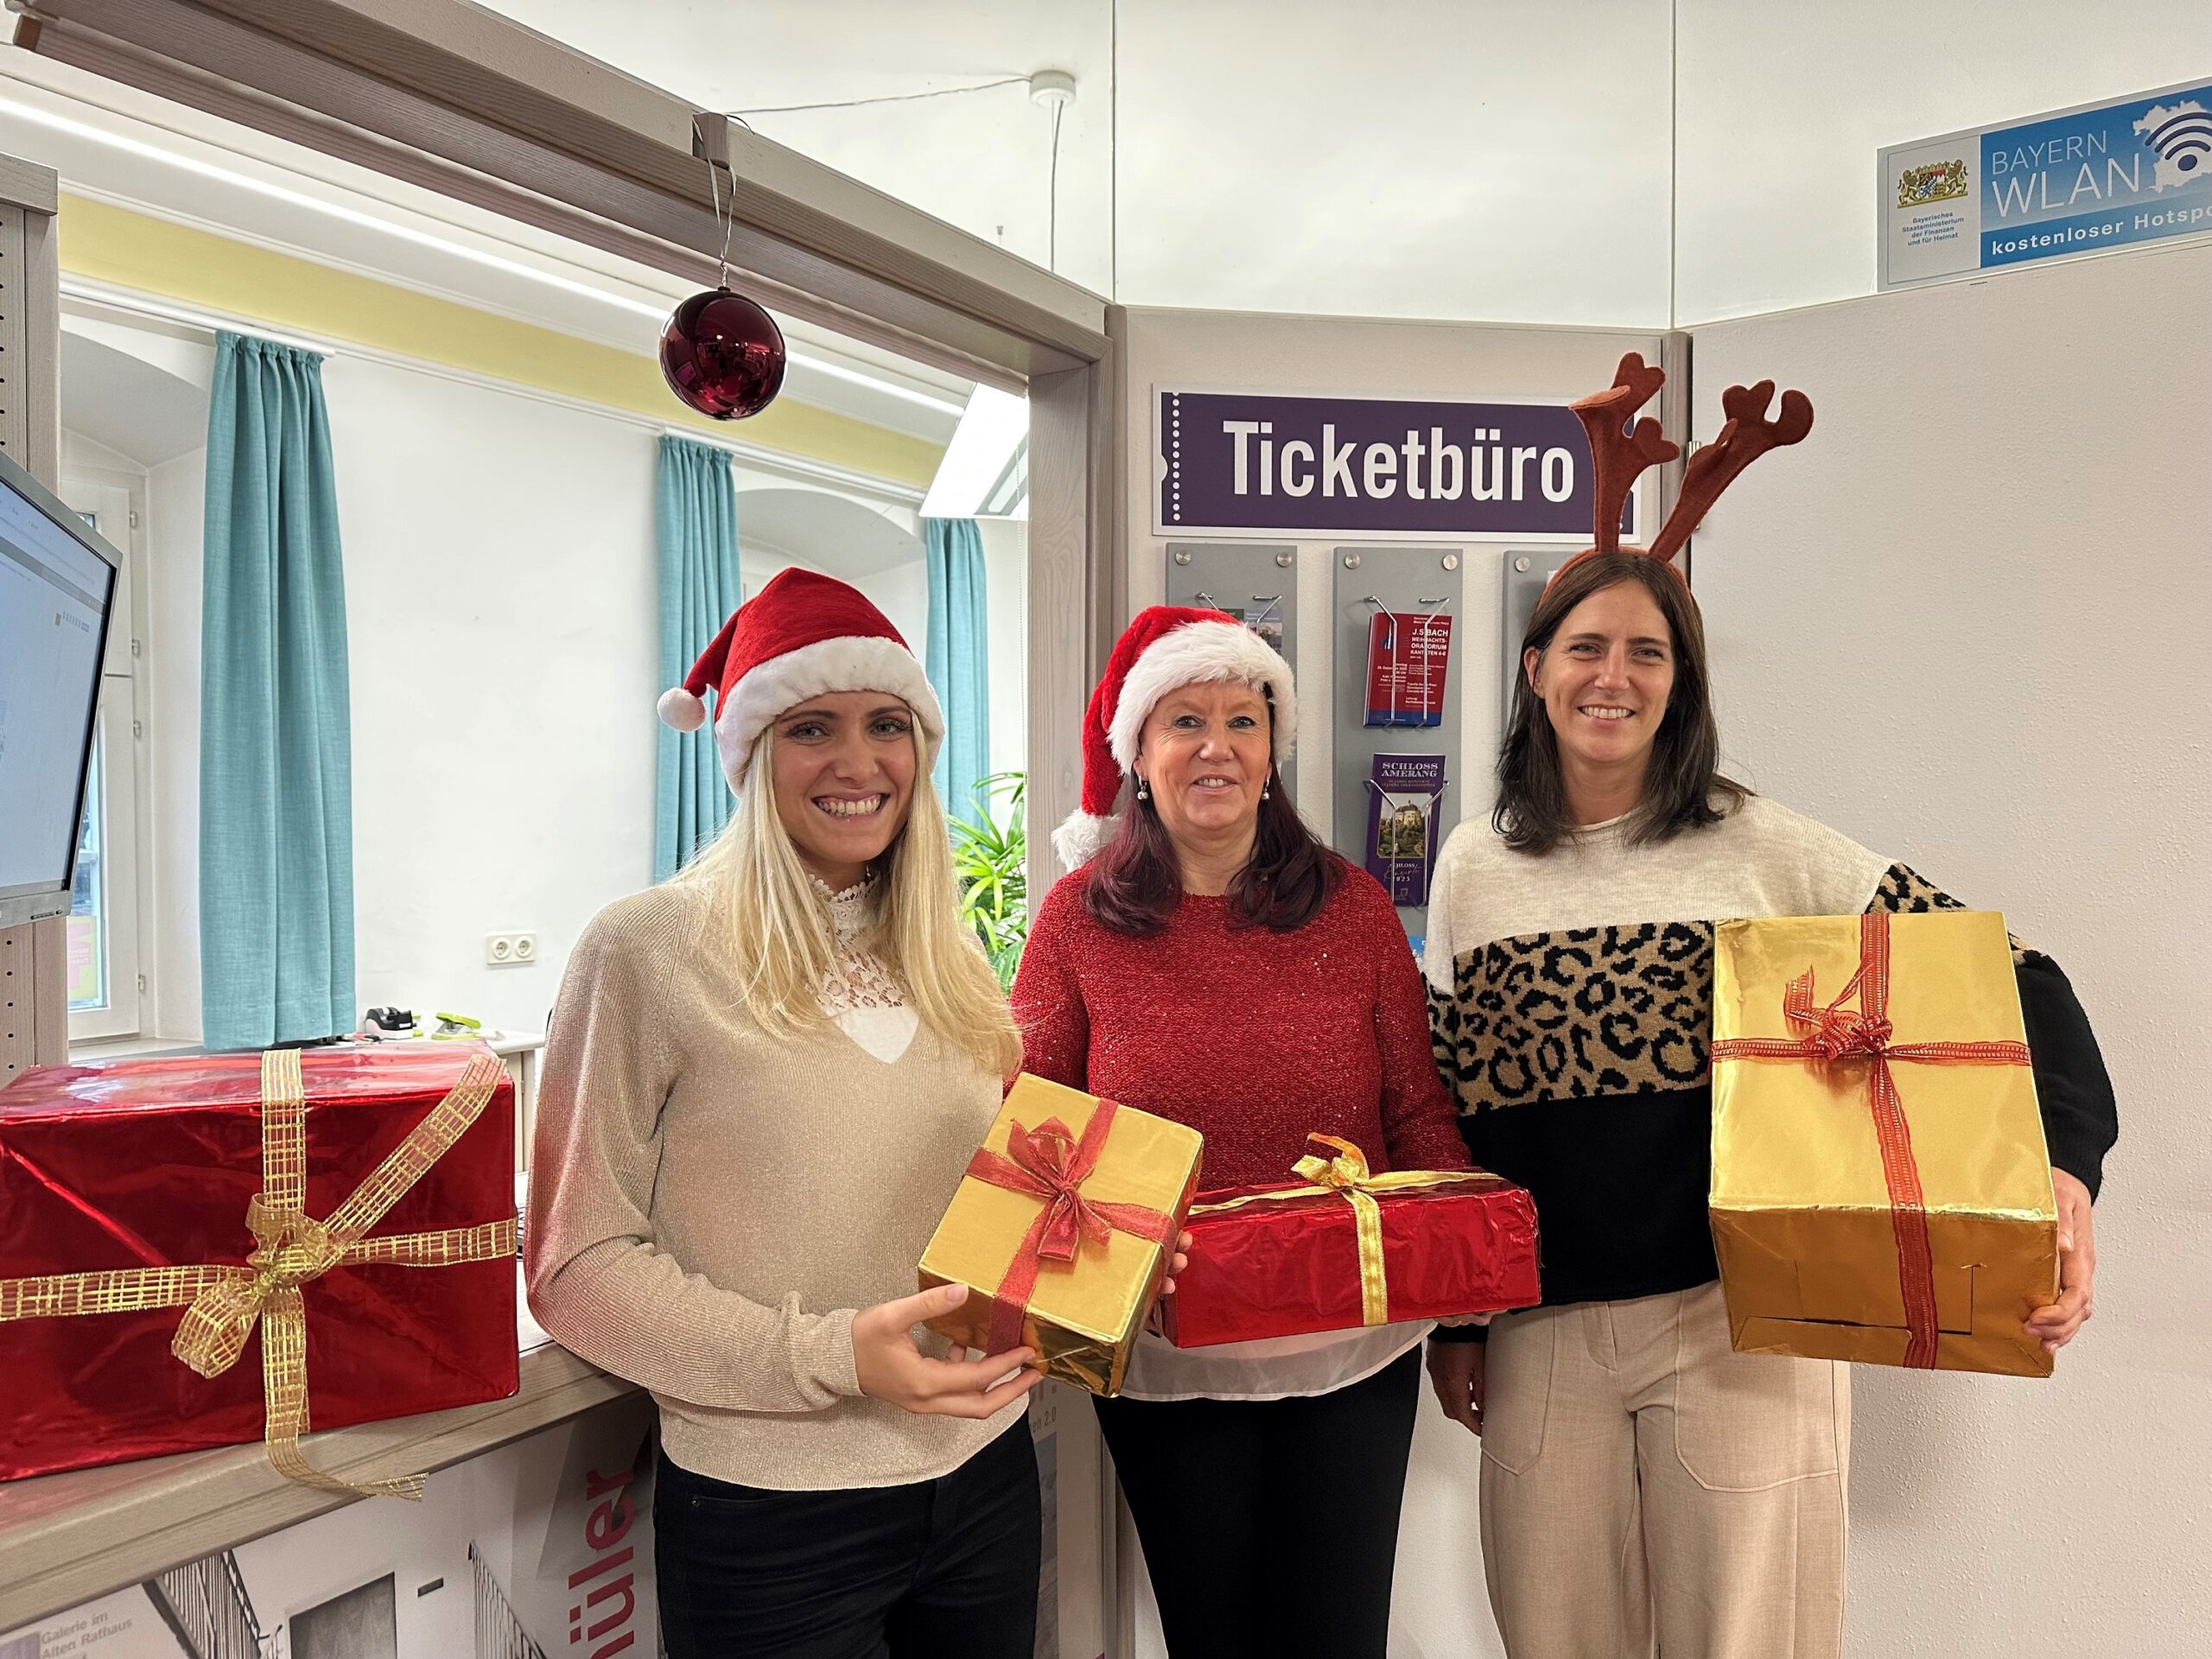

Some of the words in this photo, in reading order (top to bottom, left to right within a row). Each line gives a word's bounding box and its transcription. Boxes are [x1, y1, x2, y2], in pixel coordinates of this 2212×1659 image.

[1992, 130, 2107, 175] BAYERN
[1992, 153, 2140, 218] WLAN
[1902, 217, 1964, 232] Staatsministerium
[1912, 212, 1954, 224] Bayerisches
[1924, 226, 1955, 237] Finanzen
[1934, 232, 1959, 242] Heimat
[1992, 219, 2125, 256] kostenloser
[1223, 420, 1575, 502] Ticketbüro
[569, 1469, 635, 1659] üller
[41, 1619, 87, 1645] Galerie
[92, 1611, 109, 1625] im
[41, 1639, 77, 1659] Alten
[80, 1618, 133, 1645] Rathaus
